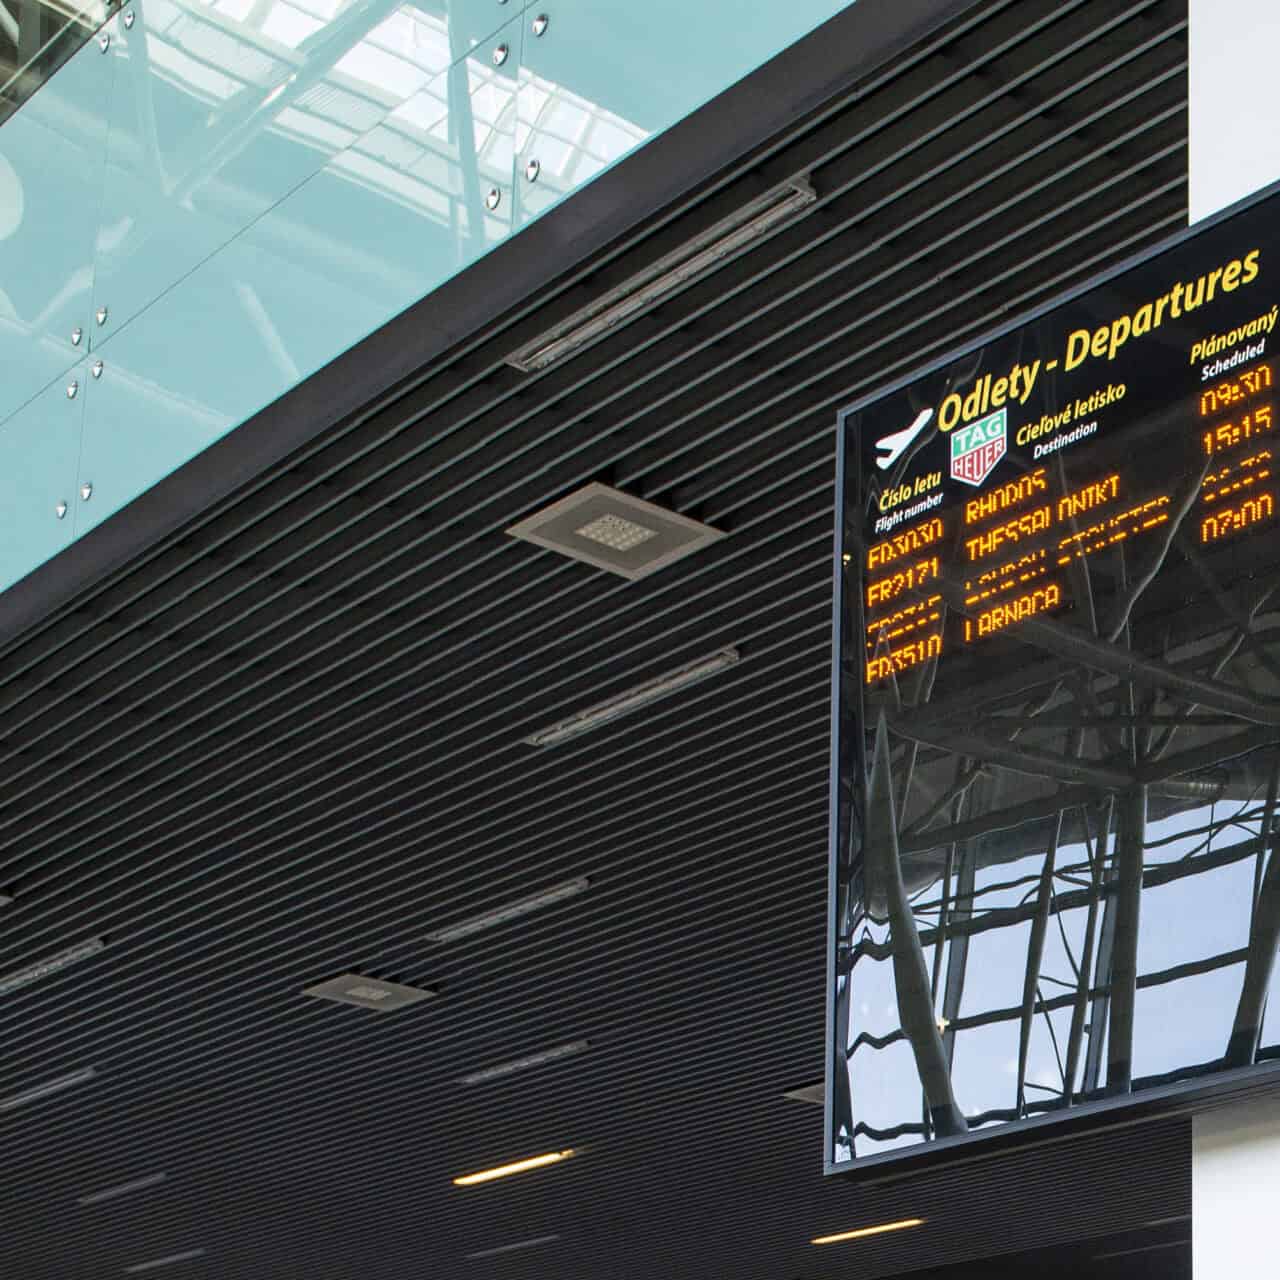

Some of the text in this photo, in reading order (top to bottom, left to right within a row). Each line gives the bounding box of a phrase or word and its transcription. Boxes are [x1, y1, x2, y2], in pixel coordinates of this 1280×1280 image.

[938, 358, 1040, 432] Odlety
[1064, 248, 1261, 372] Departures
[1190, 306, 1278, 365] Plánovaný
[1200, 340, 1265, 381] Scheduled
[955, 417, 1001, 451] TAG
[1016, 382, 1126, 447] Cieľové letisko
[953, 440, 1002, 482] HEUER
[1033, 420, 1098, 460] Destination
[879, 471, 942, 511] Číslo letu
[875, 492, 944, 534] Flight number
